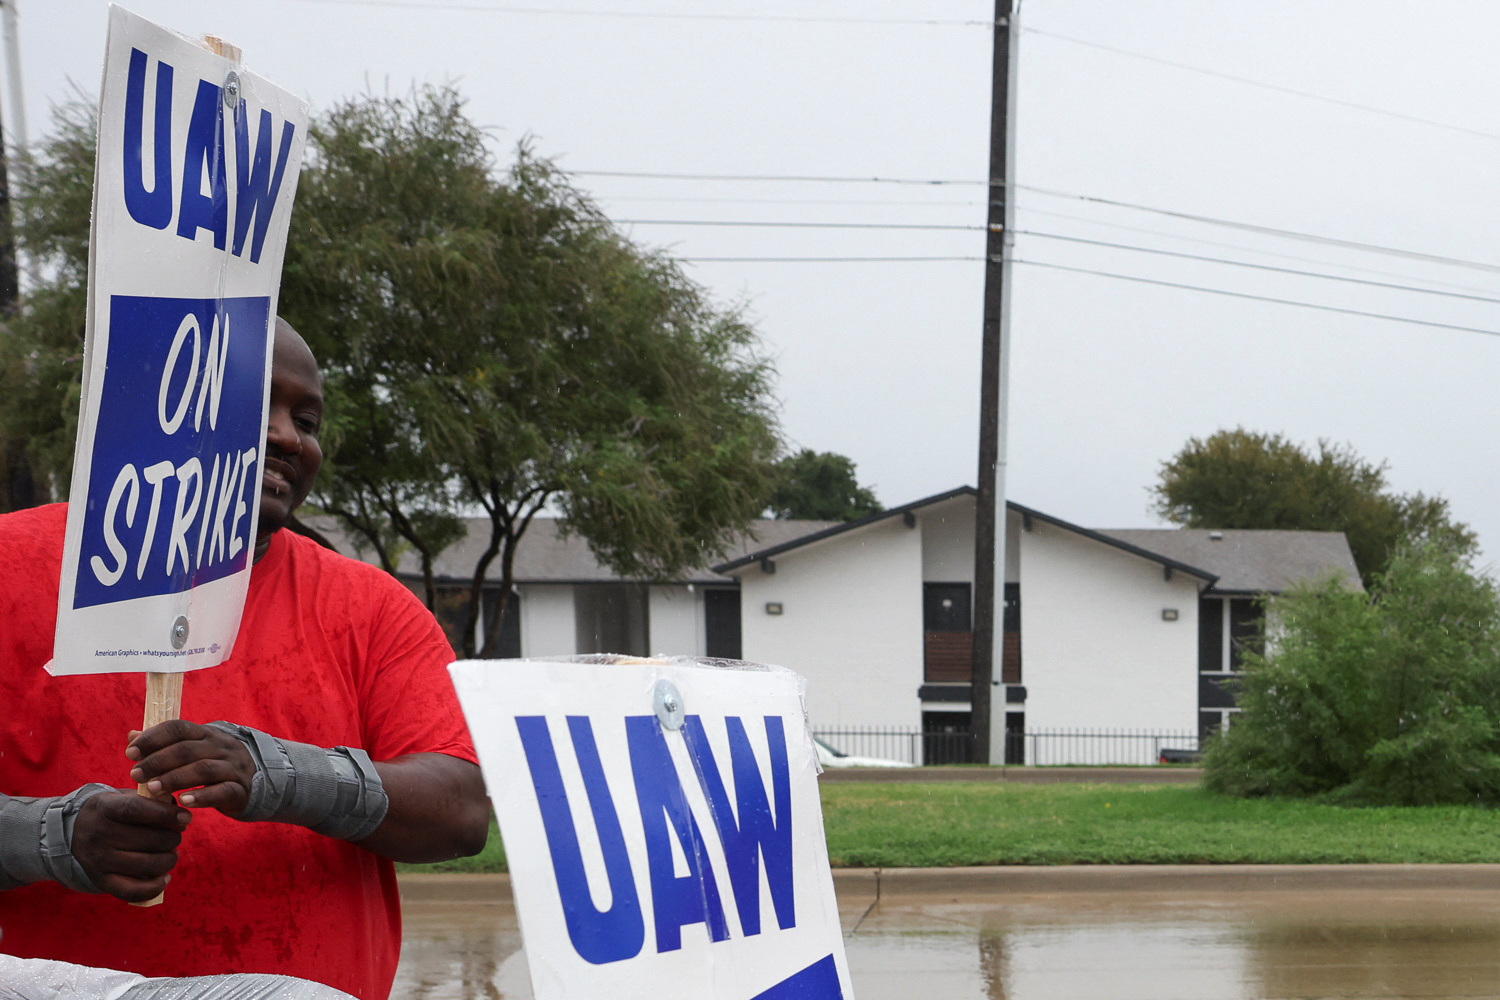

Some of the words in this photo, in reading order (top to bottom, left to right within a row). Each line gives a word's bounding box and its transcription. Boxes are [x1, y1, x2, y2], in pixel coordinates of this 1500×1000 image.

[123, 47, 295, 264] UAW
[158, 312, 230, 436] ON
[90, 446, 257, 587] STRIKE
[95, 649, 117, 657] American
[118, 649, 139, 658] Graphics
[514, 715, 796, 966] UAW
